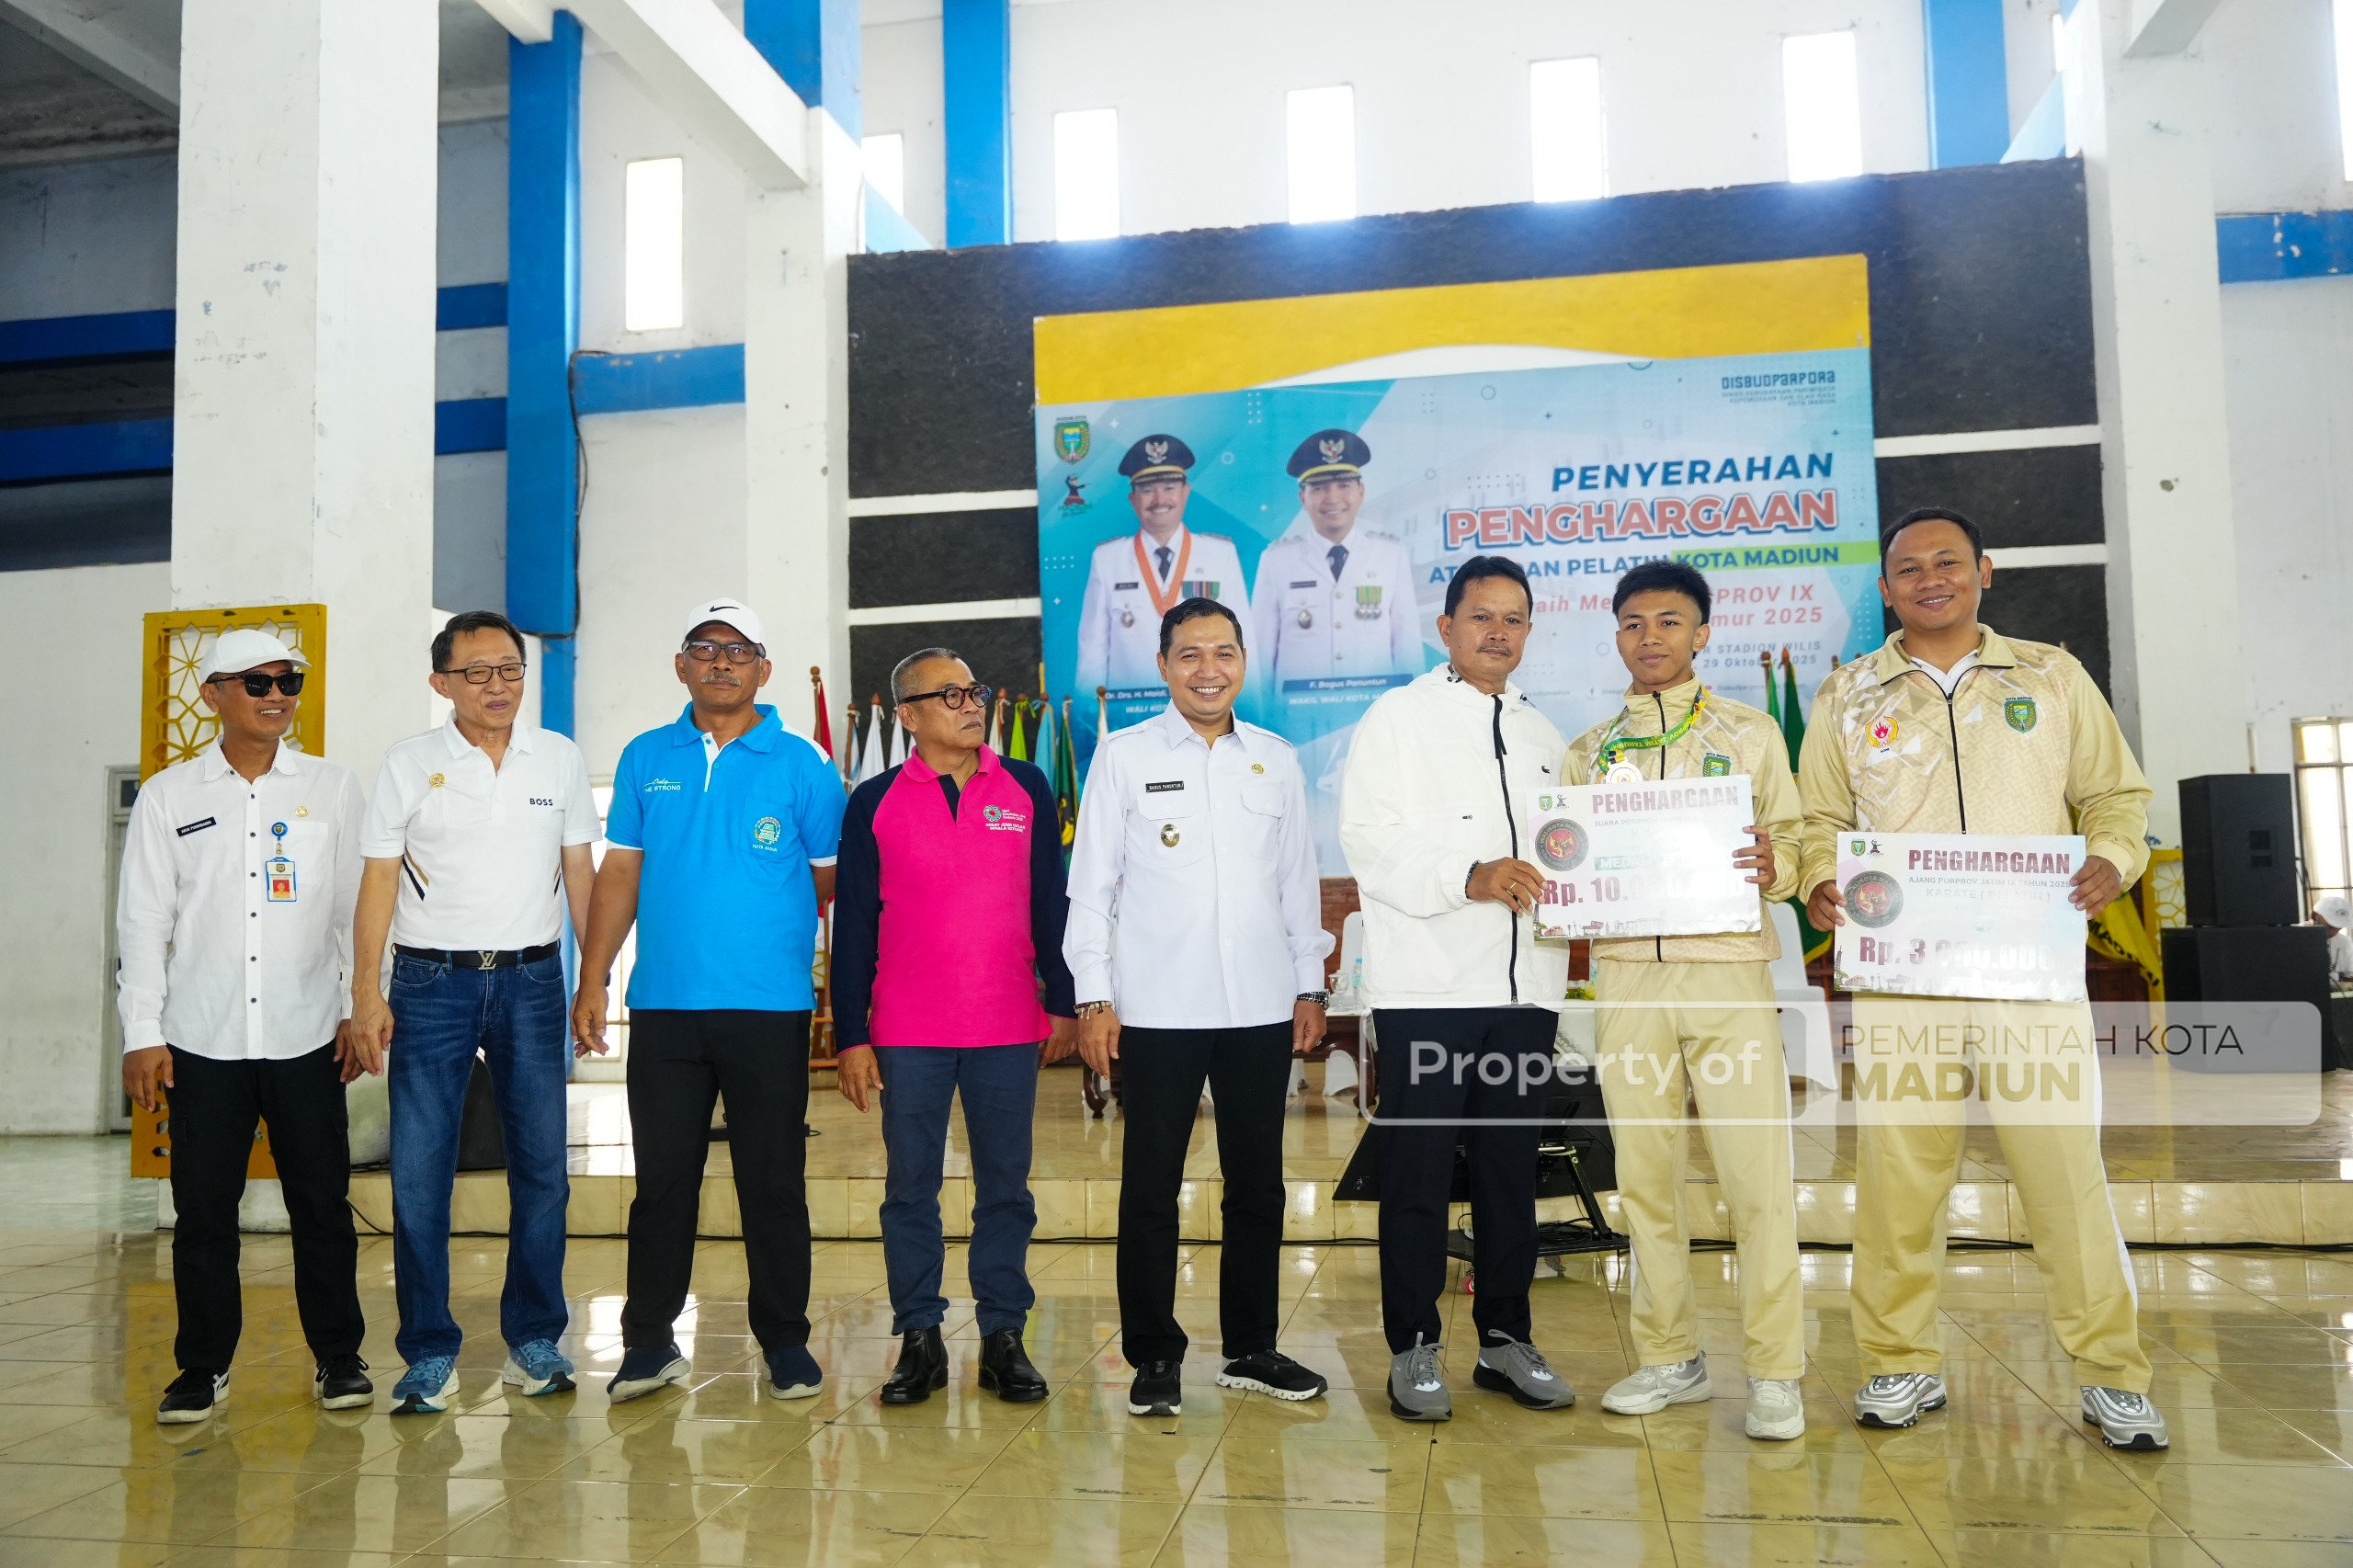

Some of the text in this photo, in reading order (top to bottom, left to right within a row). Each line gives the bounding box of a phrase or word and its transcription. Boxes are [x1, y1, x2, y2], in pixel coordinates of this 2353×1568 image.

[1552, 452, 1833, 492] PENYERAHAN
[1443, 489, 1837, 551] PENGHARGAAN
[1526, 560, 1560, 577] AN
[1676, 551, 1739, 569] KOTA
[1744, 546, 1839, 566] MADIUN
[1535, 597, 1570, 613] aih
[1716, 585, 1780, 605] PROV
[1790, 584, 1813, 602] IX
[1711, 607, 1823, 627] mur 2025
[1717, 642, 1776, 654] STADION
[1703, 658, 1718, 668] 29
[1318, 680, 1344, 689] Bagus
[1346, 678, 1387, 687] Panuntun
[1289, 697, 1318, 705] WAKIL
[1320, 696, 1344, 704] WALI
[1346, 694, 1370, 702] KOTA
[1125, 705, 1149, 713] WALI
[529, 798, 553, 806] BOSS
[1592, 786, 1739, 814] PENGHARGAAN
[1595, 819, 1620, 827] JUARA
[1908, 849, 2070, 874] PENGHARGAAN
[1909, 876, 1937, 885] AJANG
[1938, 877, 1978, 886] PORPROV
[2018, 880, 2048, 888] TAHUN
[1544, 879, 1584, 906] Rp.
[1926, 888, 1977, 899] KARATE
[1859, 936, 1901, 966] Rp.
